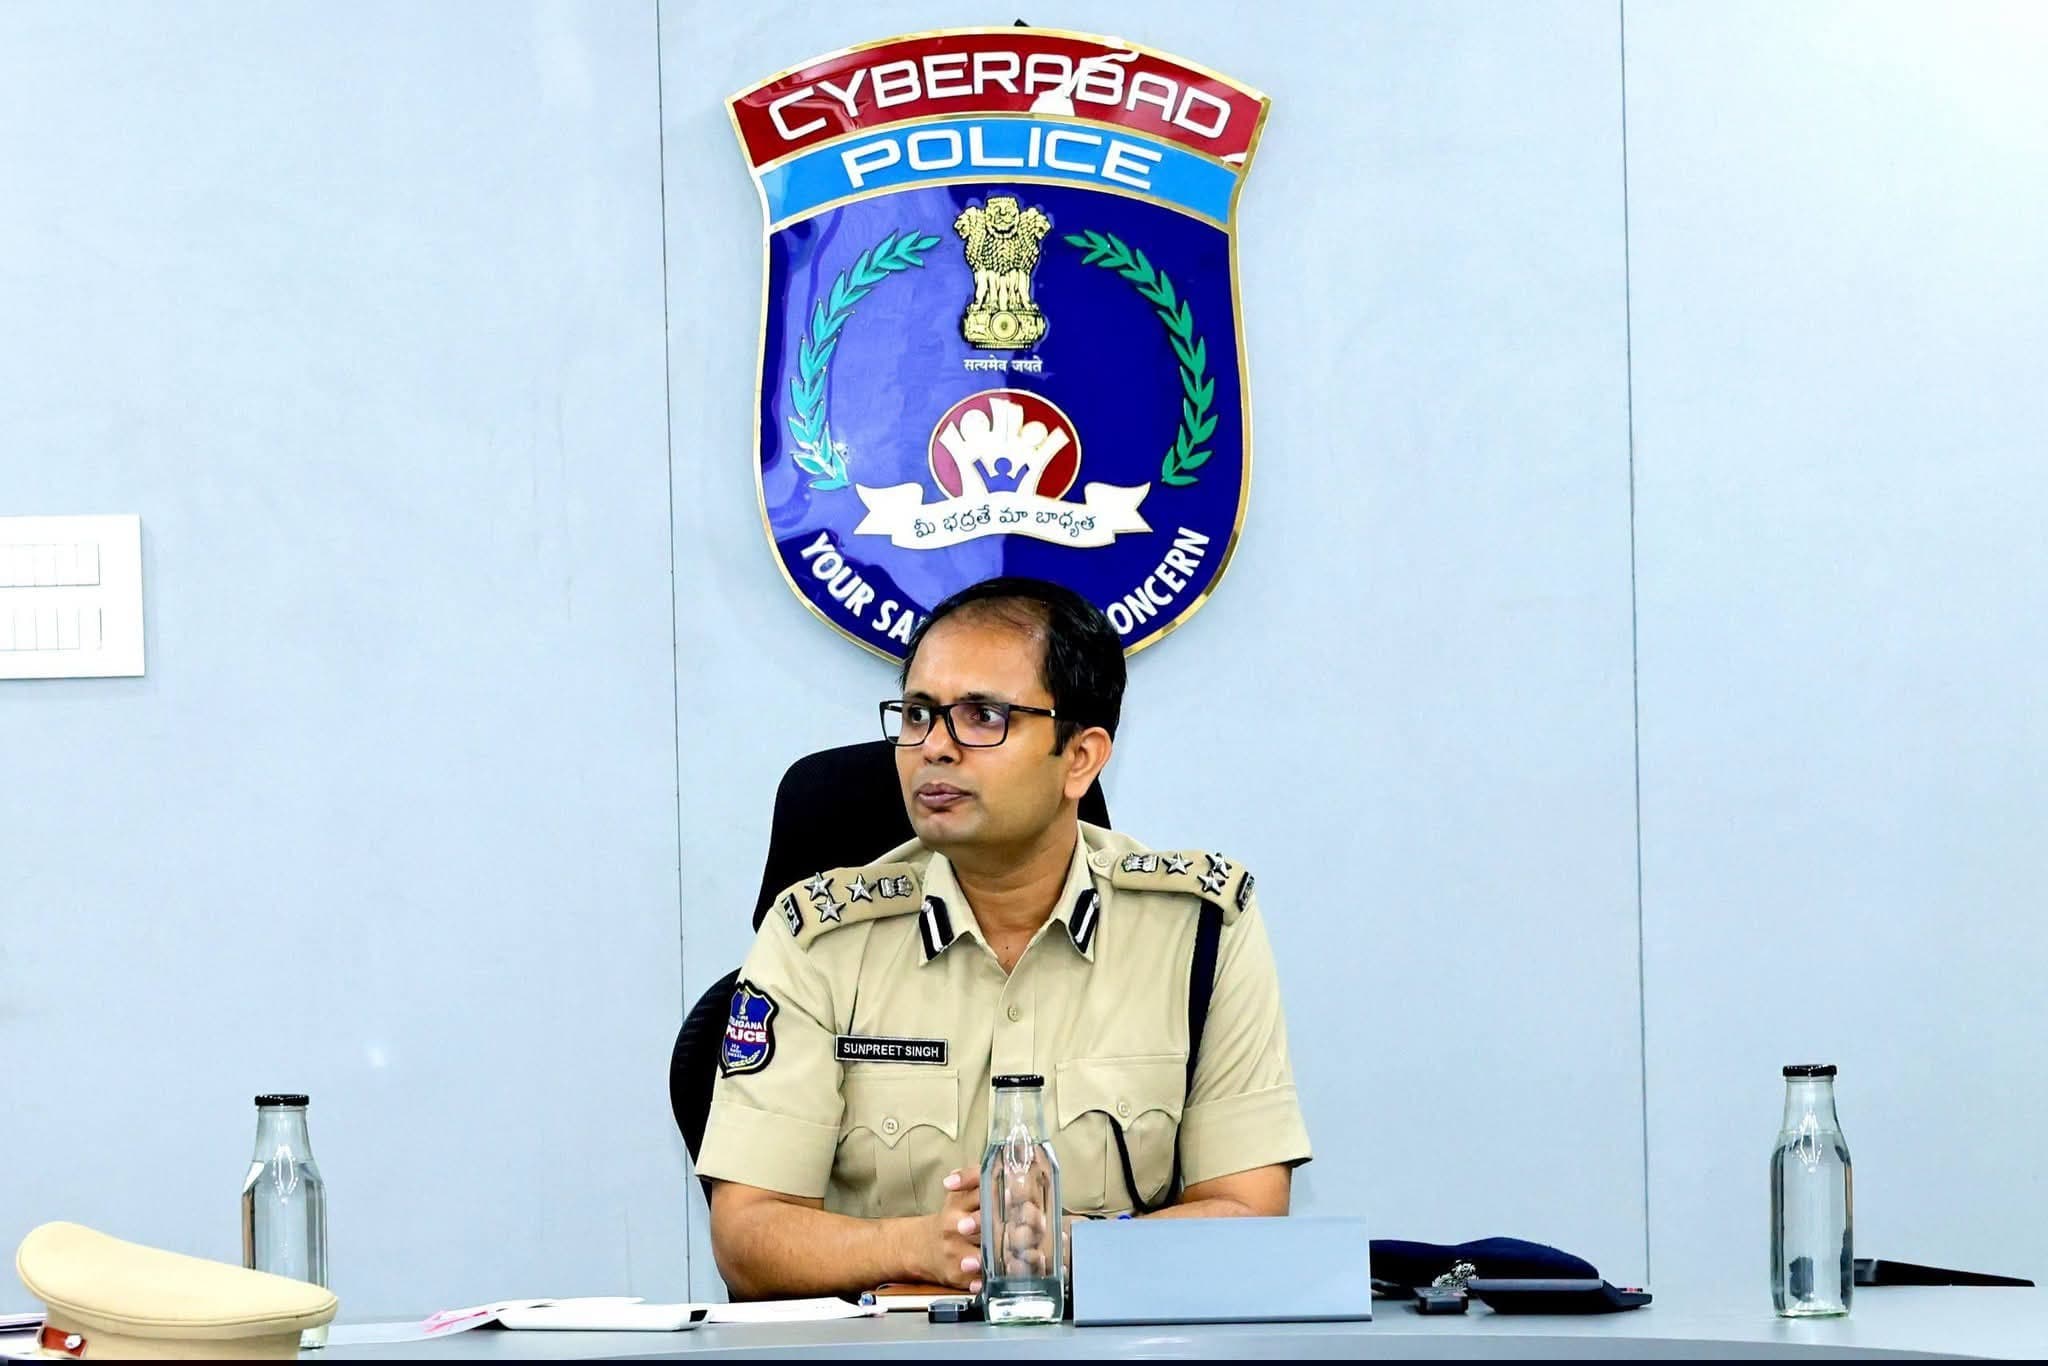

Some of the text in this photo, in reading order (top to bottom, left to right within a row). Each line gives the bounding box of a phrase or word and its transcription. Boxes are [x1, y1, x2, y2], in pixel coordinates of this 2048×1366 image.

[768, 50, 1232, 141] CYBERABAD
[841, 126, 1163, 190] POLICE
[963, 354, 1043, 373] सत्यमेव जयते
[914, 504, 1096, 538] మీ భద్రతే మా బాధ్యత
[800, 531, 875, 617] YOUR
[1101, 526, 1210, 635] ONCERN
[843, 1042, 939, 1058] SUNPREET SINGH
